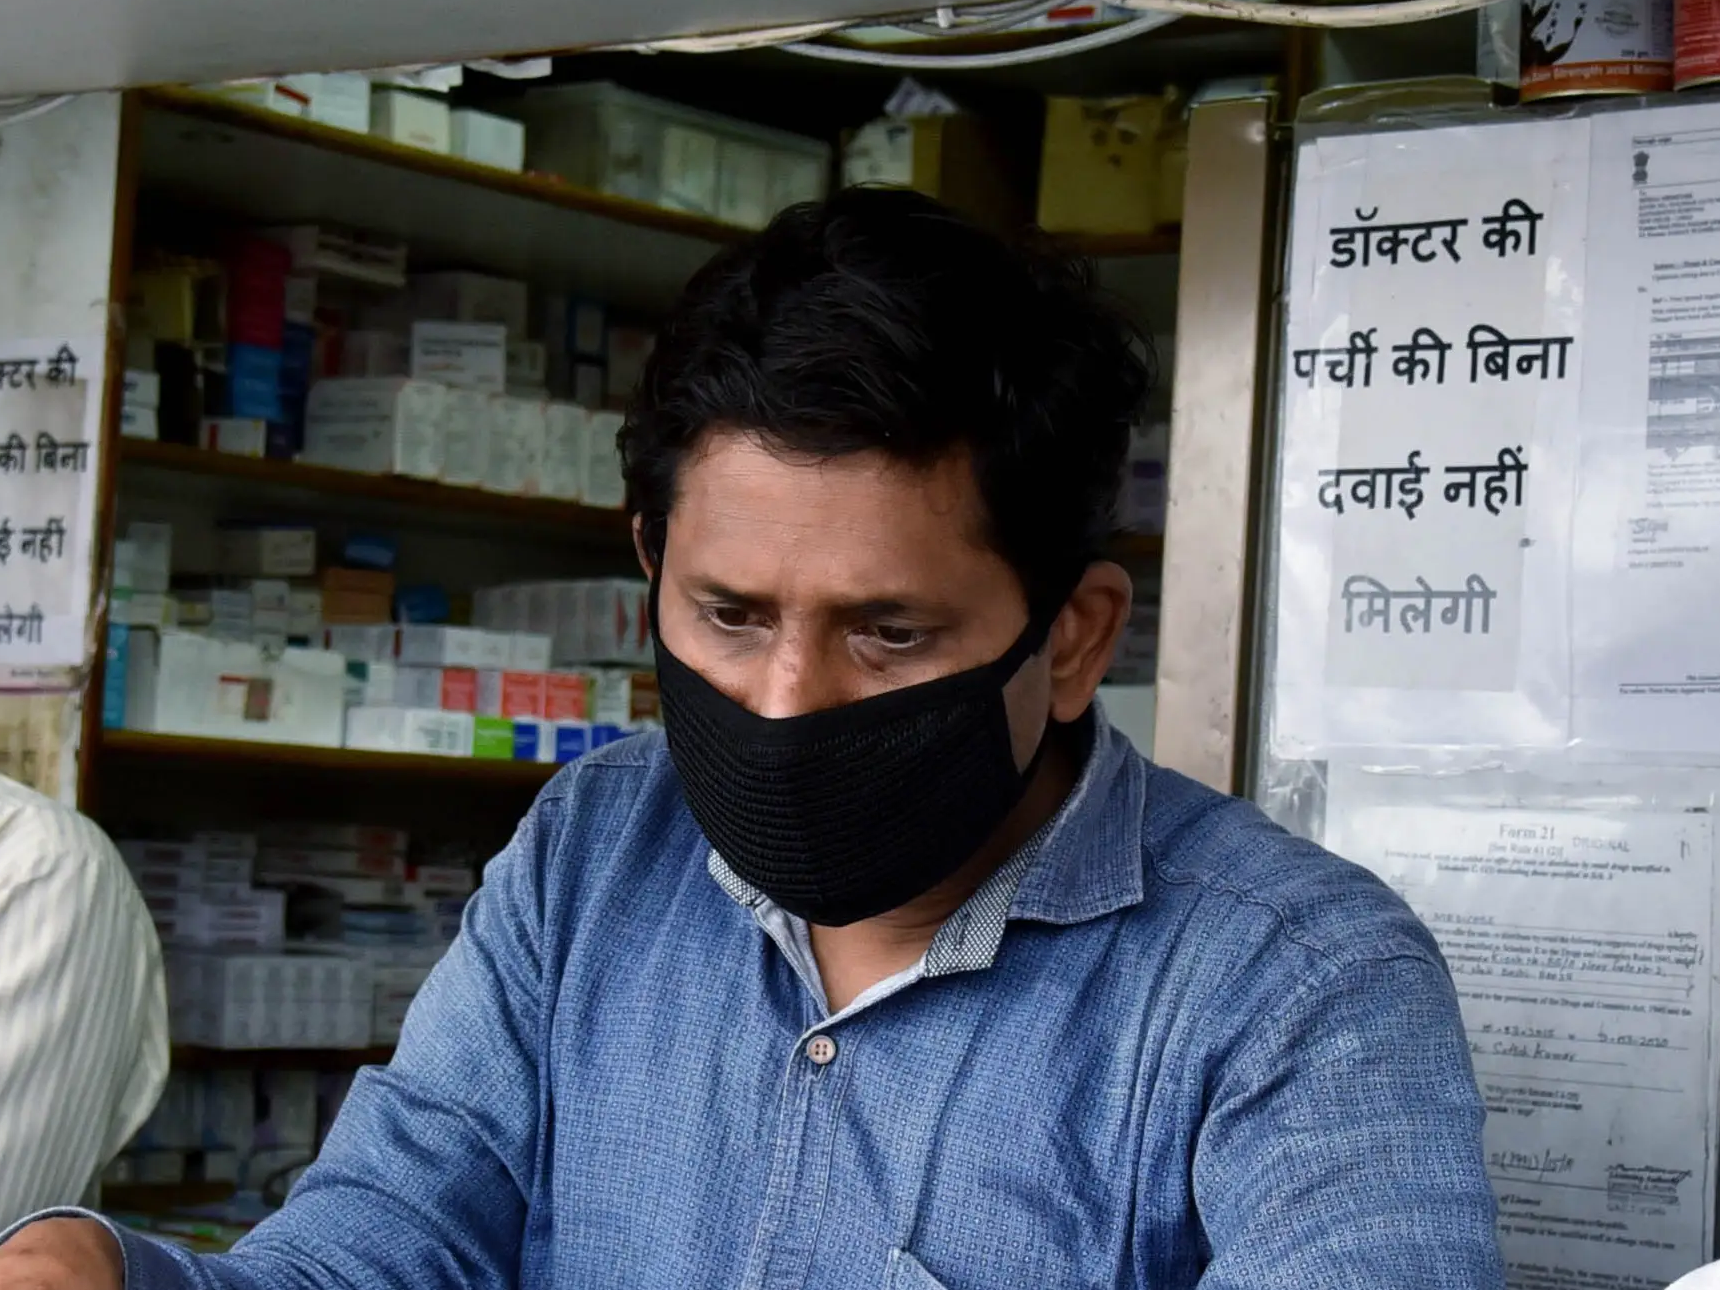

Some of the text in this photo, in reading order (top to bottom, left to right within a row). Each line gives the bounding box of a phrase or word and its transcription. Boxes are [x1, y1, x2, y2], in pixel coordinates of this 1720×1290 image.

[1329, 198, 1545, 269] डॉक्टर की
[44, 341, 79, 388] की
[1293, 323, 1575, 390] पर्ची की बिना
[33, 432, 89, 474] बिना
[1317, 445, 1529, 521] दवाई नहीं
[21, 515, 66, 560] नहीं
[1342, 573, 1496, 636] मिलेगी
